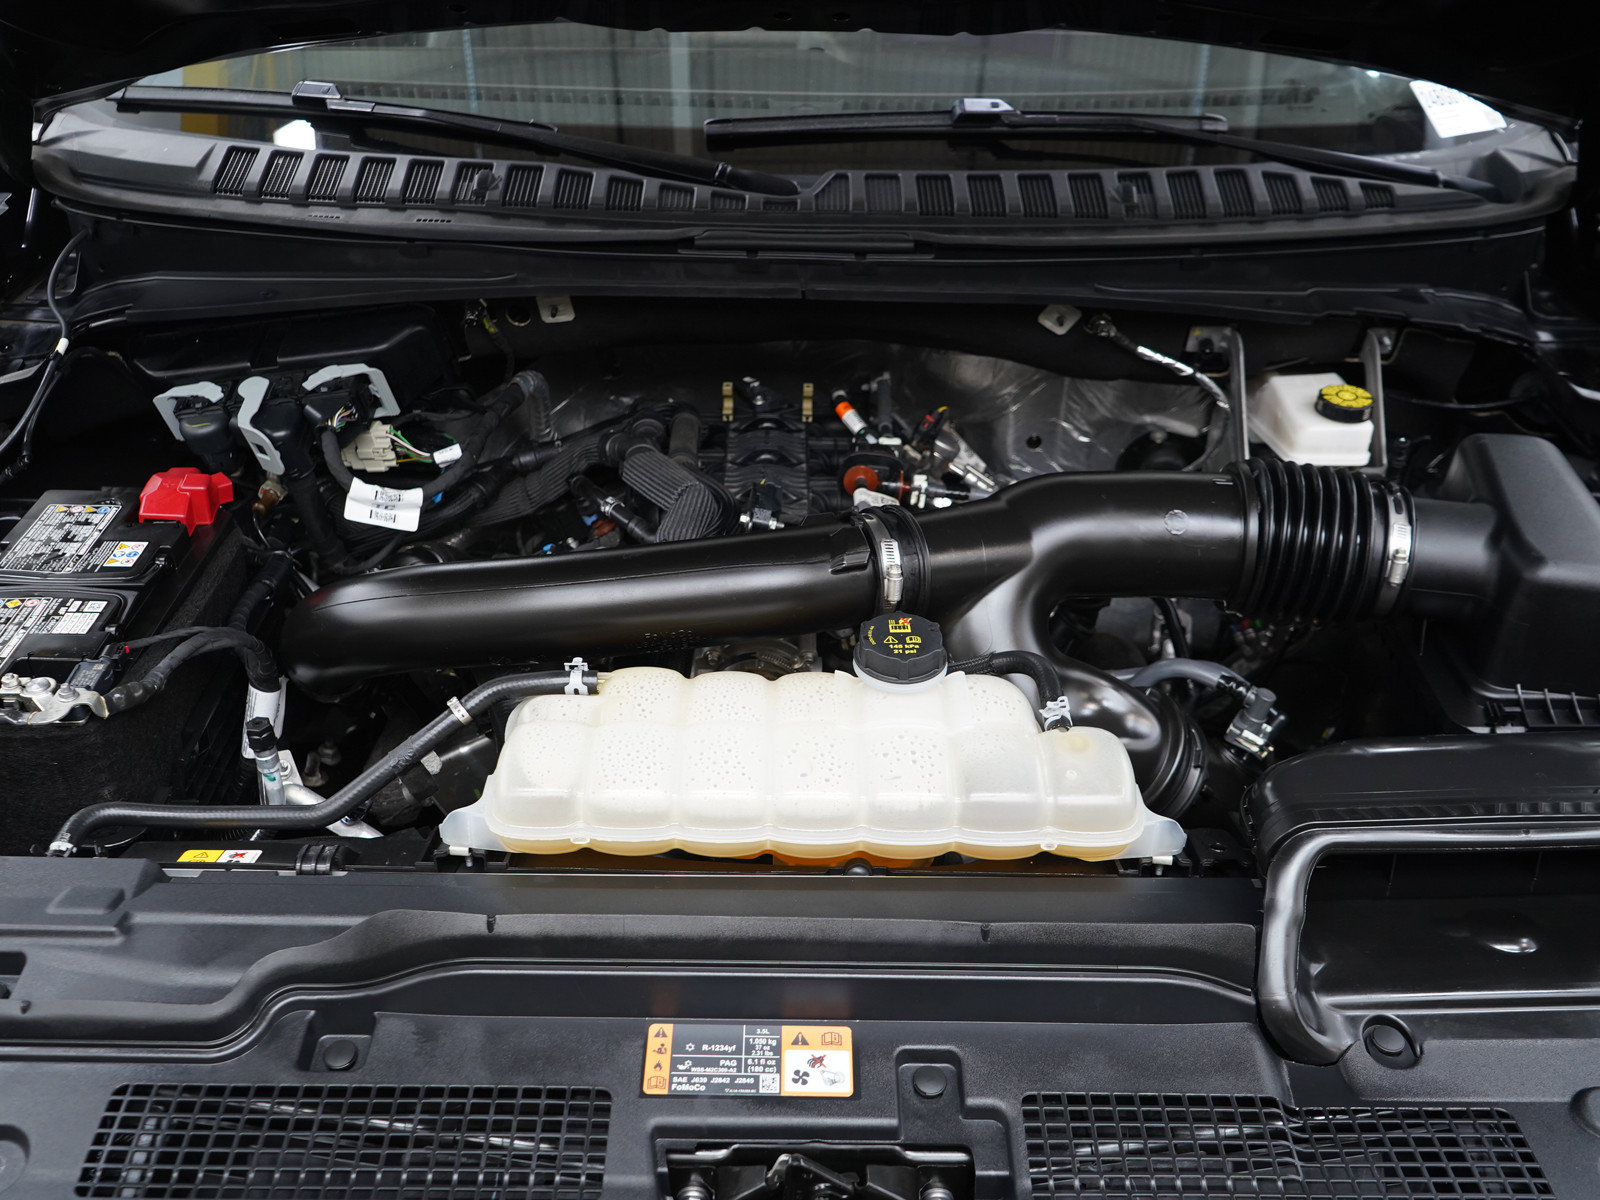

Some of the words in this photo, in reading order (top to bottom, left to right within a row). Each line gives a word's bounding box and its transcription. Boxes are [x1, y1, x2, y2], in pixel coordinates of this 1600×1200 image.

[768, 1038, 777, 1047] kg
[702, 1044, 736, 1052] R-1234yf
[764, 1066, 777, 1074] cc)
[671, 1083, 706, 1091] FoMoCo
